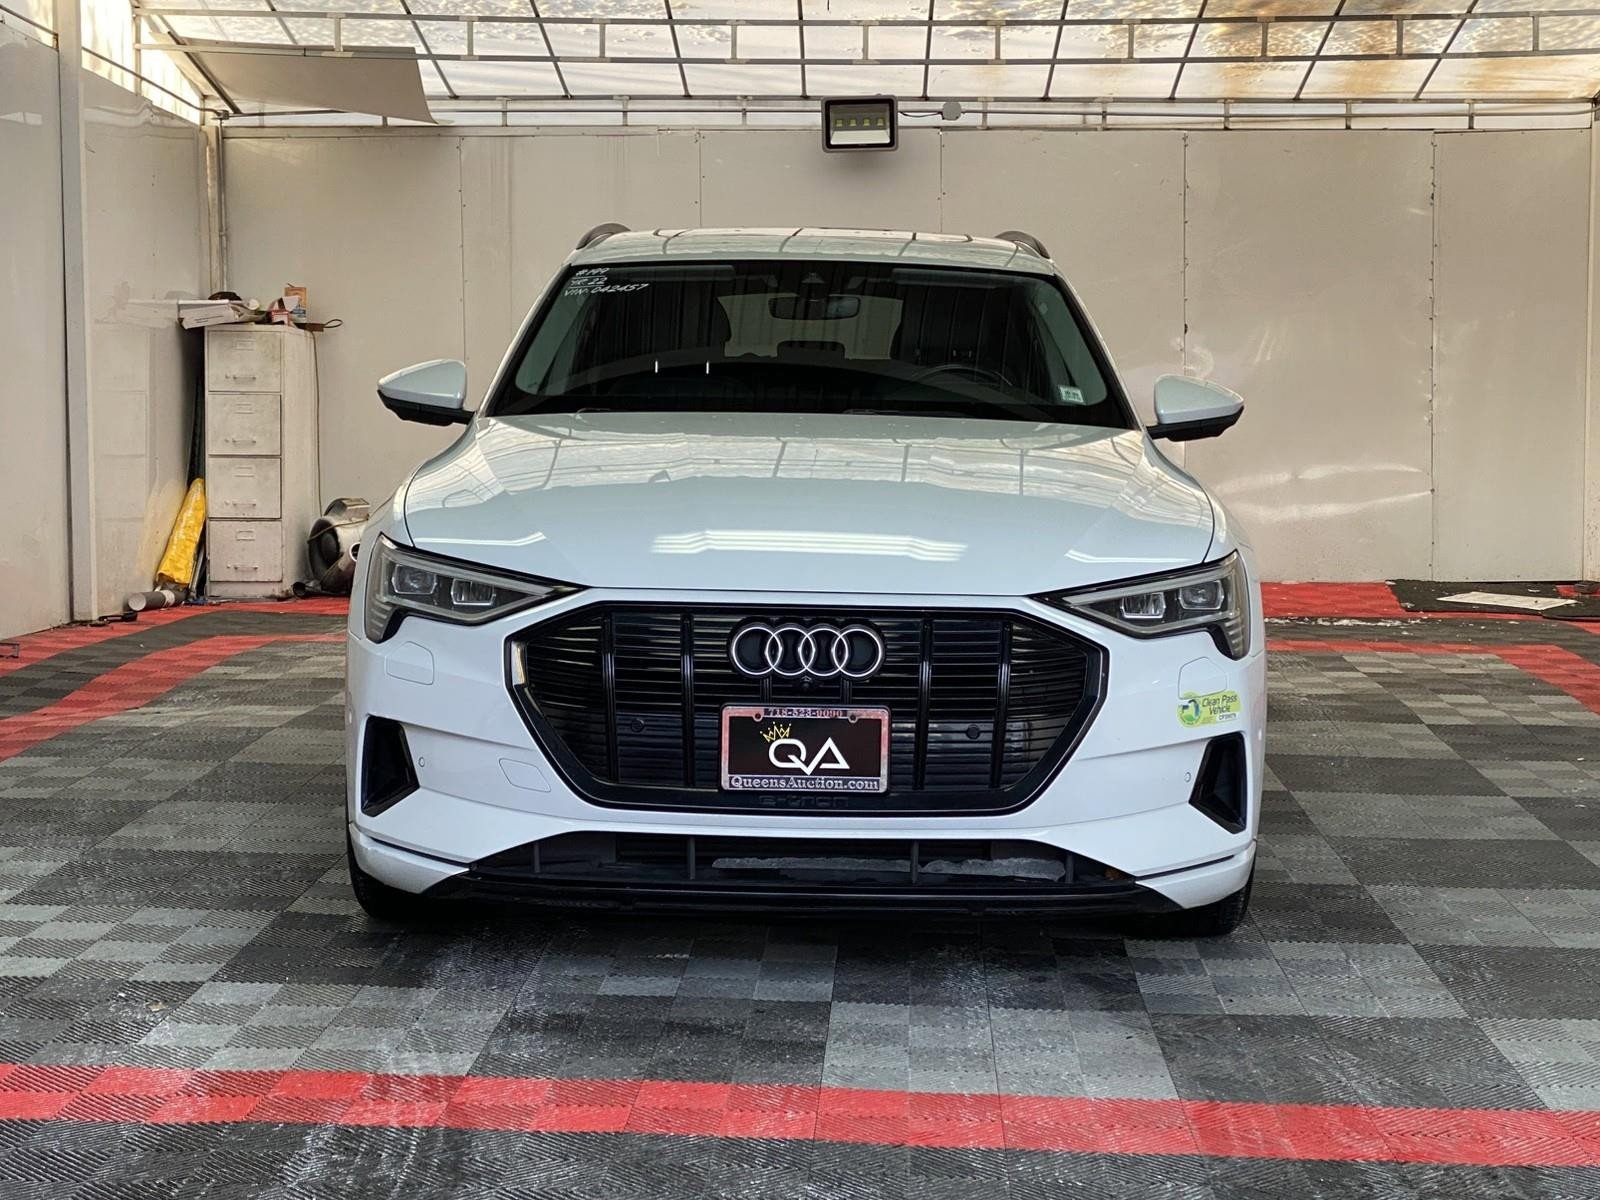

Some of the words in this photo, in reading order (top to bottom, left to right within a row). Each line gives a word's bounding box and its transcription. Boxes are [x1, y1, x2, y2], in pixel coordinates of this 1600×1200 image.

[1202, 698, 1220, 708] Clean
[1221, 694, 1238, 704] Pass
[1209, 704, 1231, 715] Vehicle
[768, 736, 851, 776] QA
[730, 776, 879, 790] QueensAuction.com
